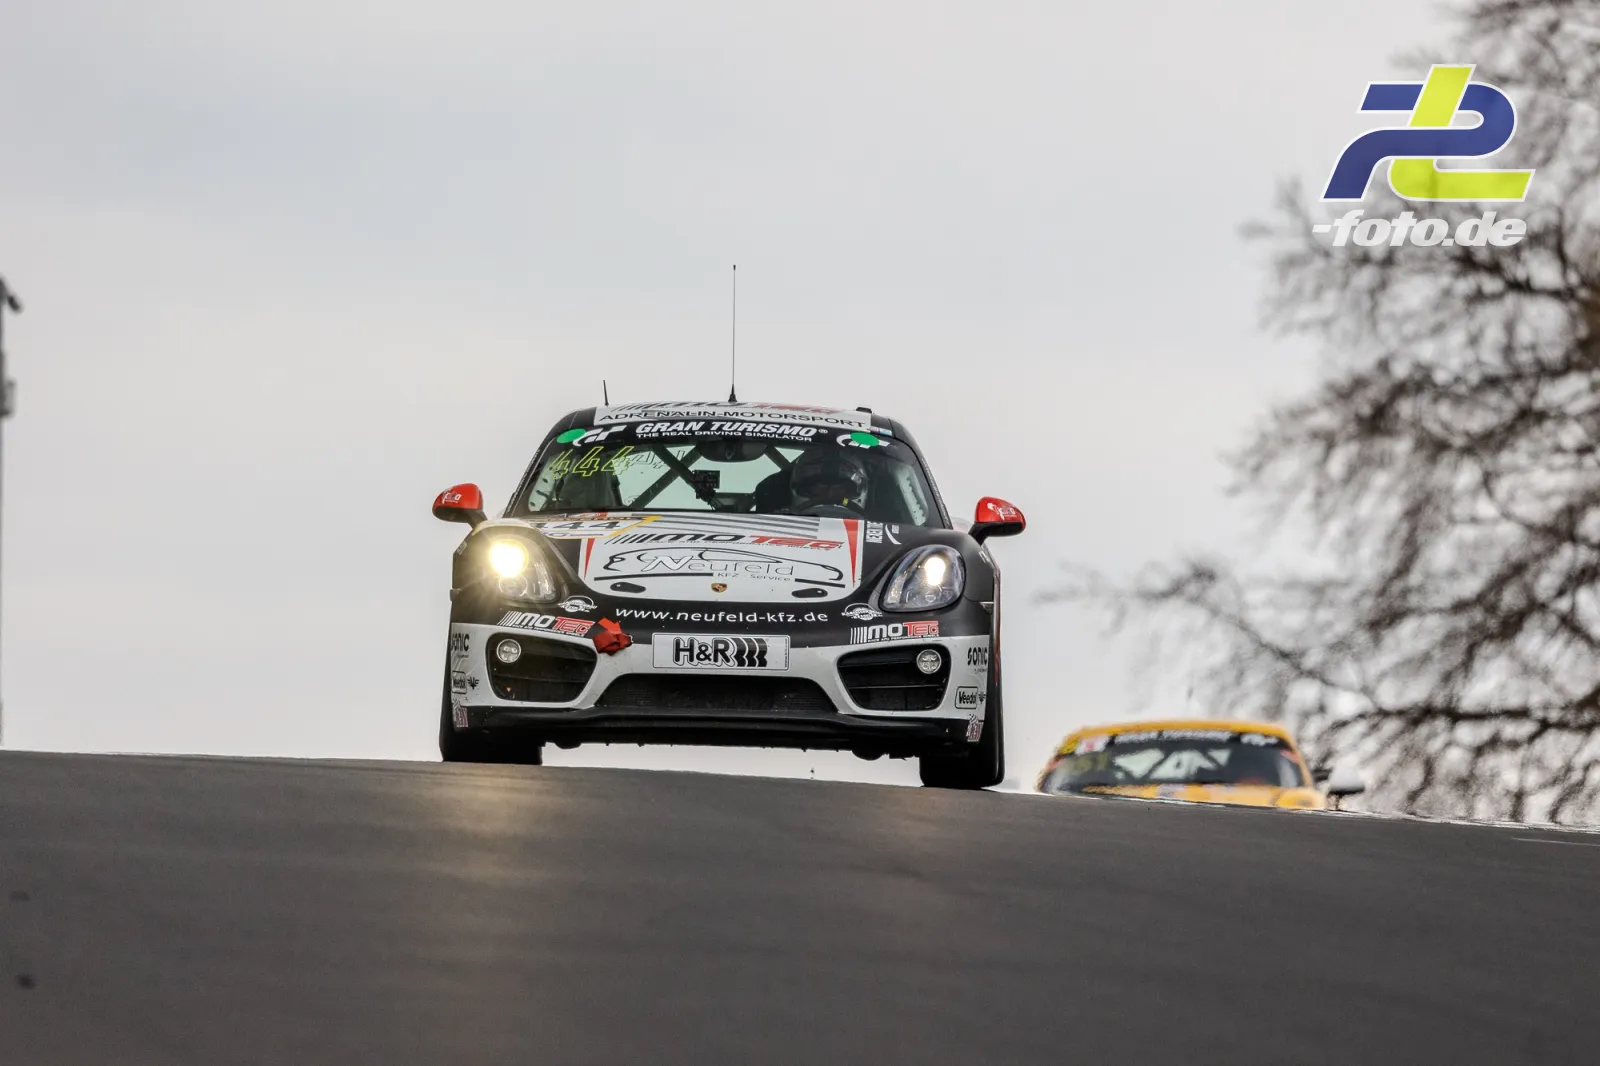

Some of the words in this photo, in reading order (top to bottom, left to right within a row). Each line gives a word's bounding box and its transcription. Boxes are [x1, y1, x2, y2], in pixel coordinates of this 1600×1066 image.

[599, 410, 867, 428] ADRENALIN-MOTORSPORT
[635, 421, 706, 433] GRAN
[745, 432, 813, 442] SIMULATOR
[641, 555, 794, 576] Neufeld
[750, 572, 791, 582] Service
[615, 607, 829, 624] www.neufeld-kfz.de
[673, 636, 736, 667] H&R
